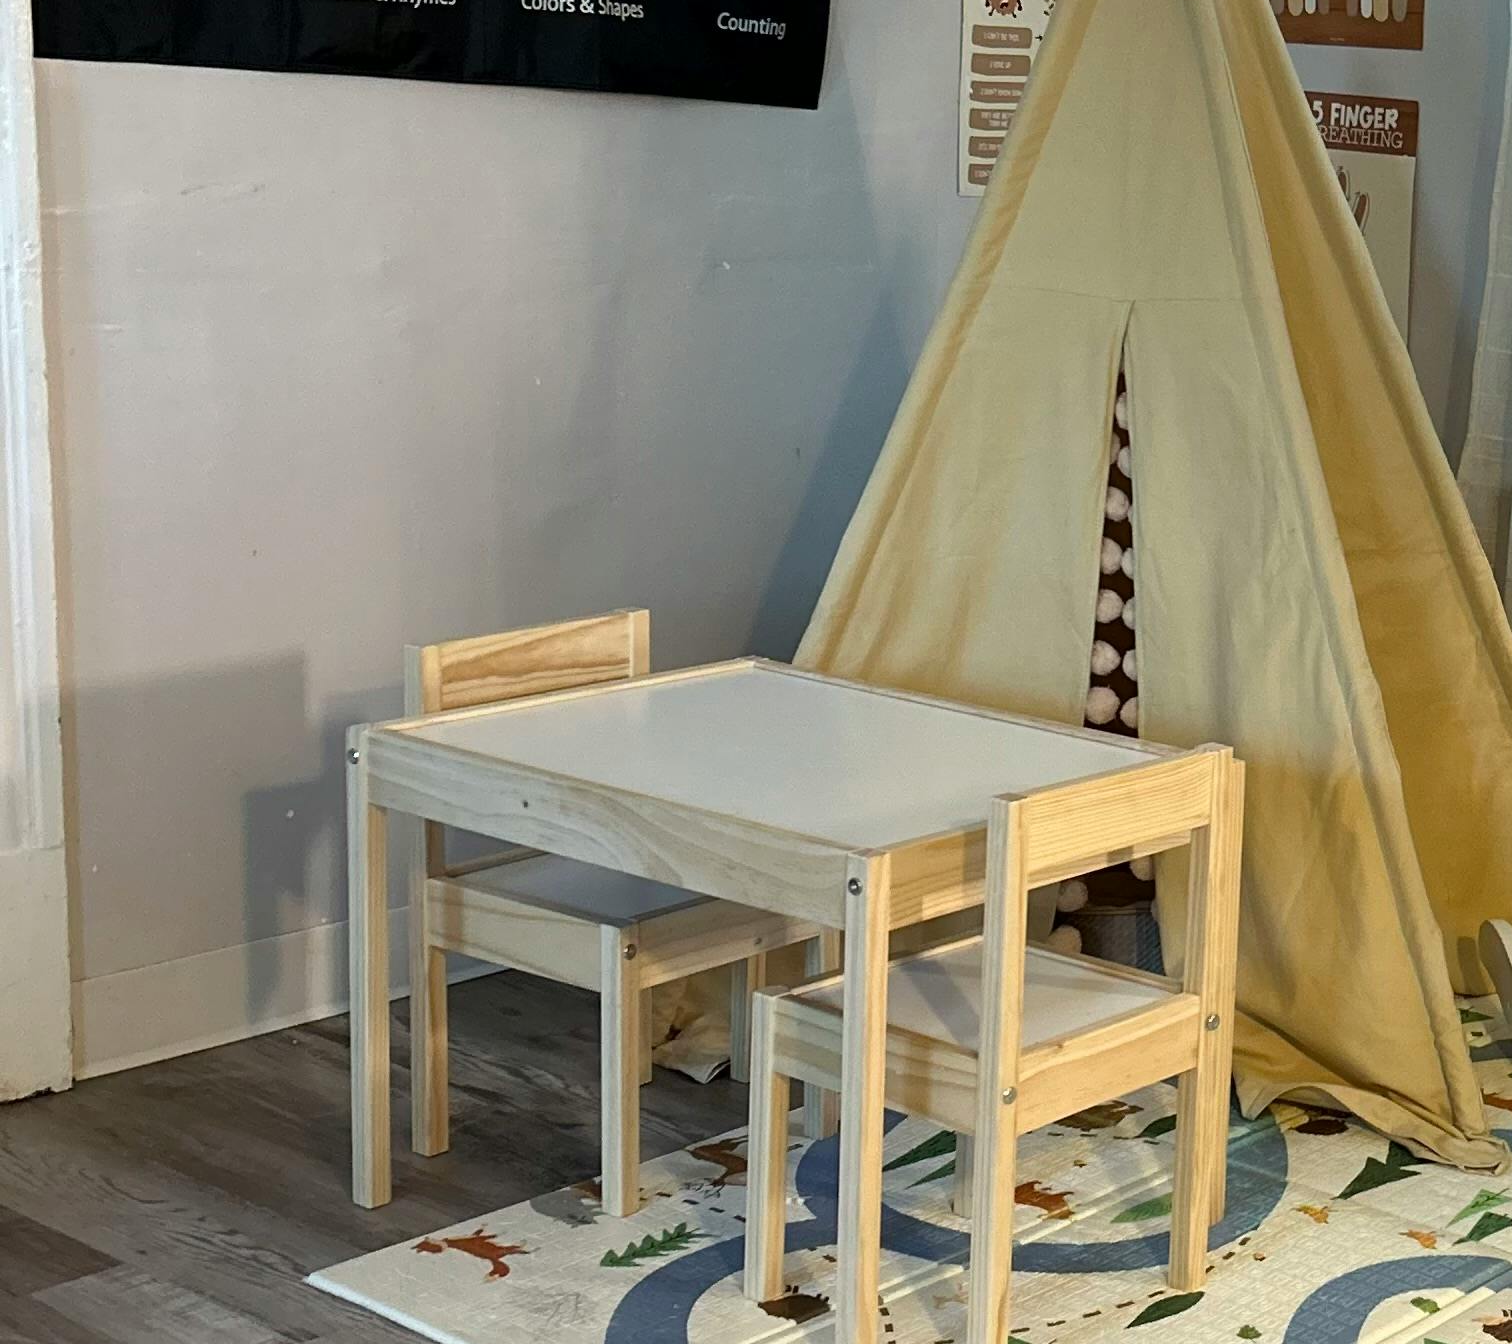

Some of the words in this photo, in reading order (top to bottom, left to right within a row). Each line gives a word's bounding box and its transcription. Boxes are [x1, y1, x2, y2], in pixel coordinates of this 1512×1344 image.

[717, 12, 786, 40] Counting
[1312, 100, 1324, 124] 5
[1330, 103, 1399, 130] FINGER
[1319, 126, 1403, 149] REATHING
